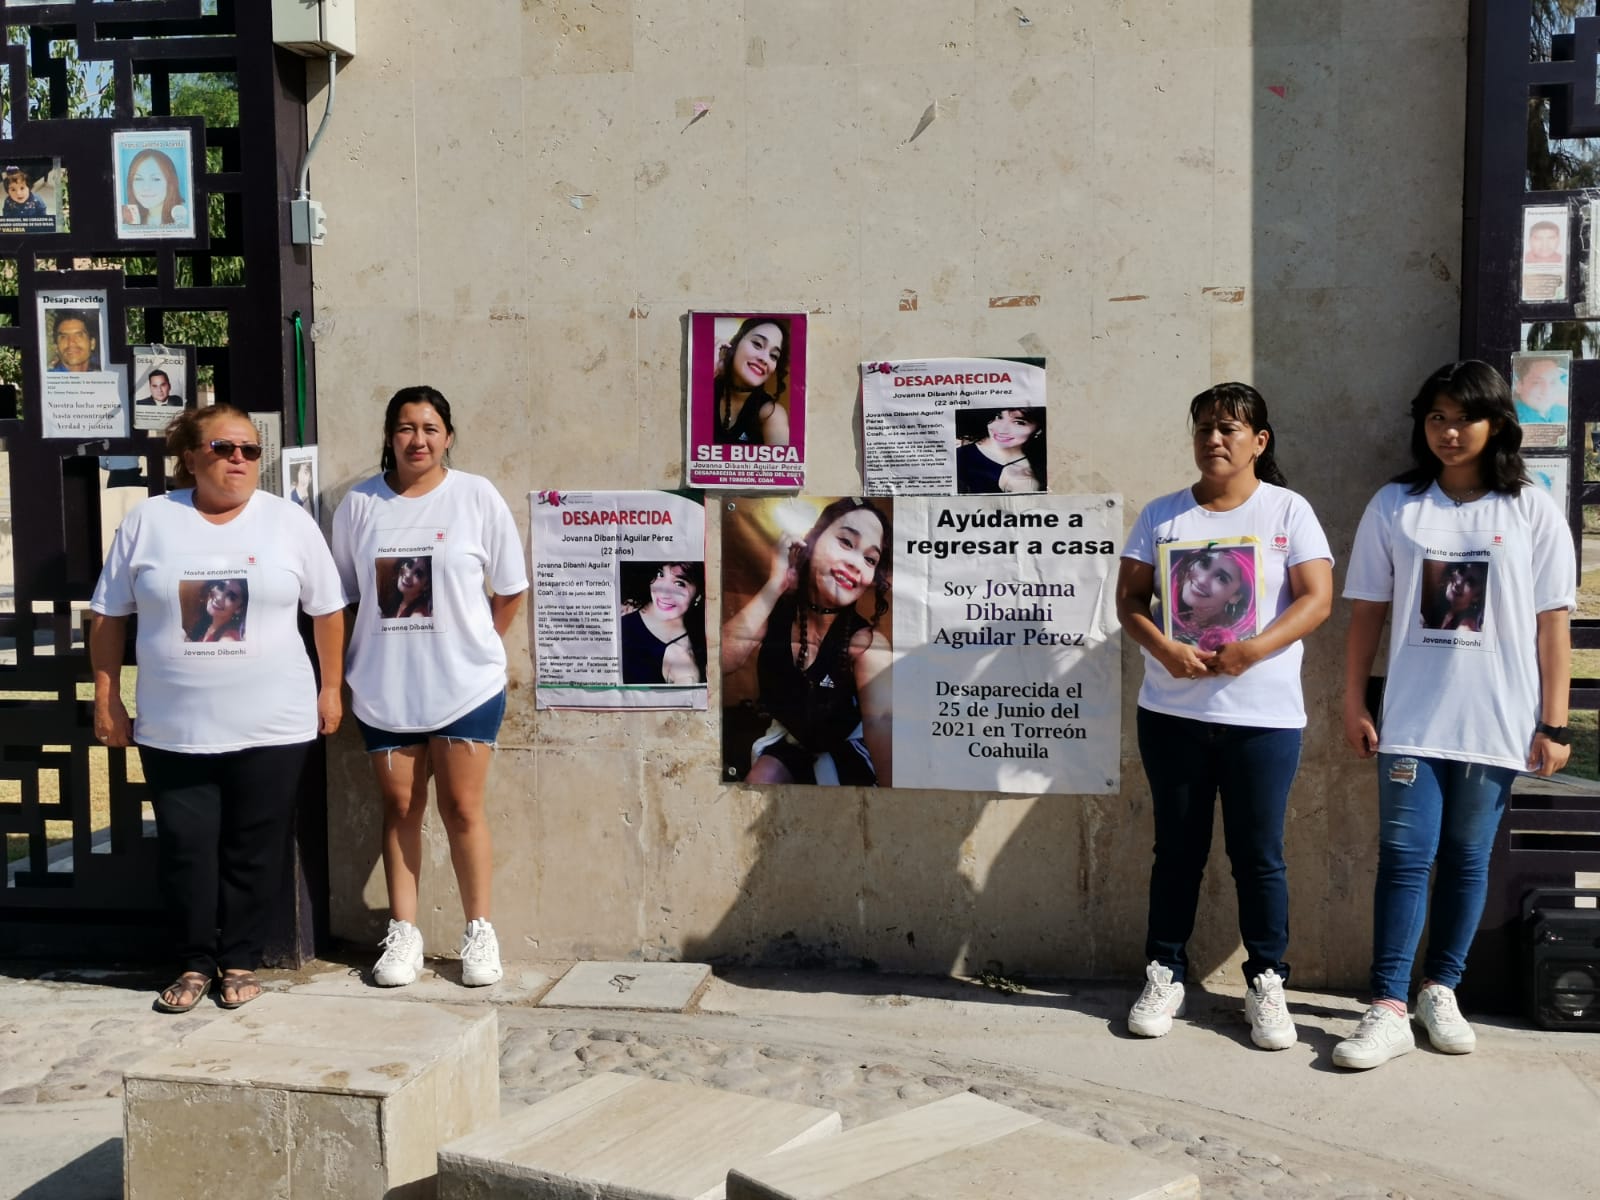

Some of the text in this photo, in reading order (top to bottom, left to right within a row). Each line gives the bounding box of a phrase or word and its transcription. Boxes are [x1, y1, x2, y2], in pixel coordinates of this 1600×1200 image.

[42, 295, 105, 305] Desaparecido
[893, 372, 1012, 388] DESAPARECIDA
[892, 391, 926, 399] Jovanna
[927, 389, 958, 398] Dibanhi
[959, 388, 988, 398] Aguilar
[934, 398, 971, 407] (22 años)
[697, 445, 799, 462] SE BUSCA
[562, 510, 673, 526] DESAPARECIDA
[936, 509, 1083, 532] Ayúdame a
[561, 534, 593, 543] Jovanna
[593, 533, 623, 542] Dibanhi
[623, 533, 650, 544] Aguilar
[601, 546, 634, 557] (22 años)
[906, 539, 1115, 559] regresar a casa
[1425, 547, 1491, 558] Hasta encontrarte
[206, 568, 248, 576] encontrarte
[536, 561, 611, 571] Jovanna Dibanhi Aguilar
[537, 580, 575, 588] desapareció
[943, 579, 1075, 600] Soy Jovanna
[965, 603, 1053, 622] Dibanhi
[409, 623, 435, 631] Dibanhi
[934, 626, 1085, 650] Aguilar Pérez
[1422, 636, 1481, 647] Jovanna Dibanhi
[183, 647, 247, 657] Jovanna Dibanhi
[935, 681, 1083, 701] Desaparecida el
[938, 701, 1080, 720] 25 de Junio del
[932, 721, 1087, 741] 2021 en Torreón
[968, 741, 1049, 760] Coahuila
